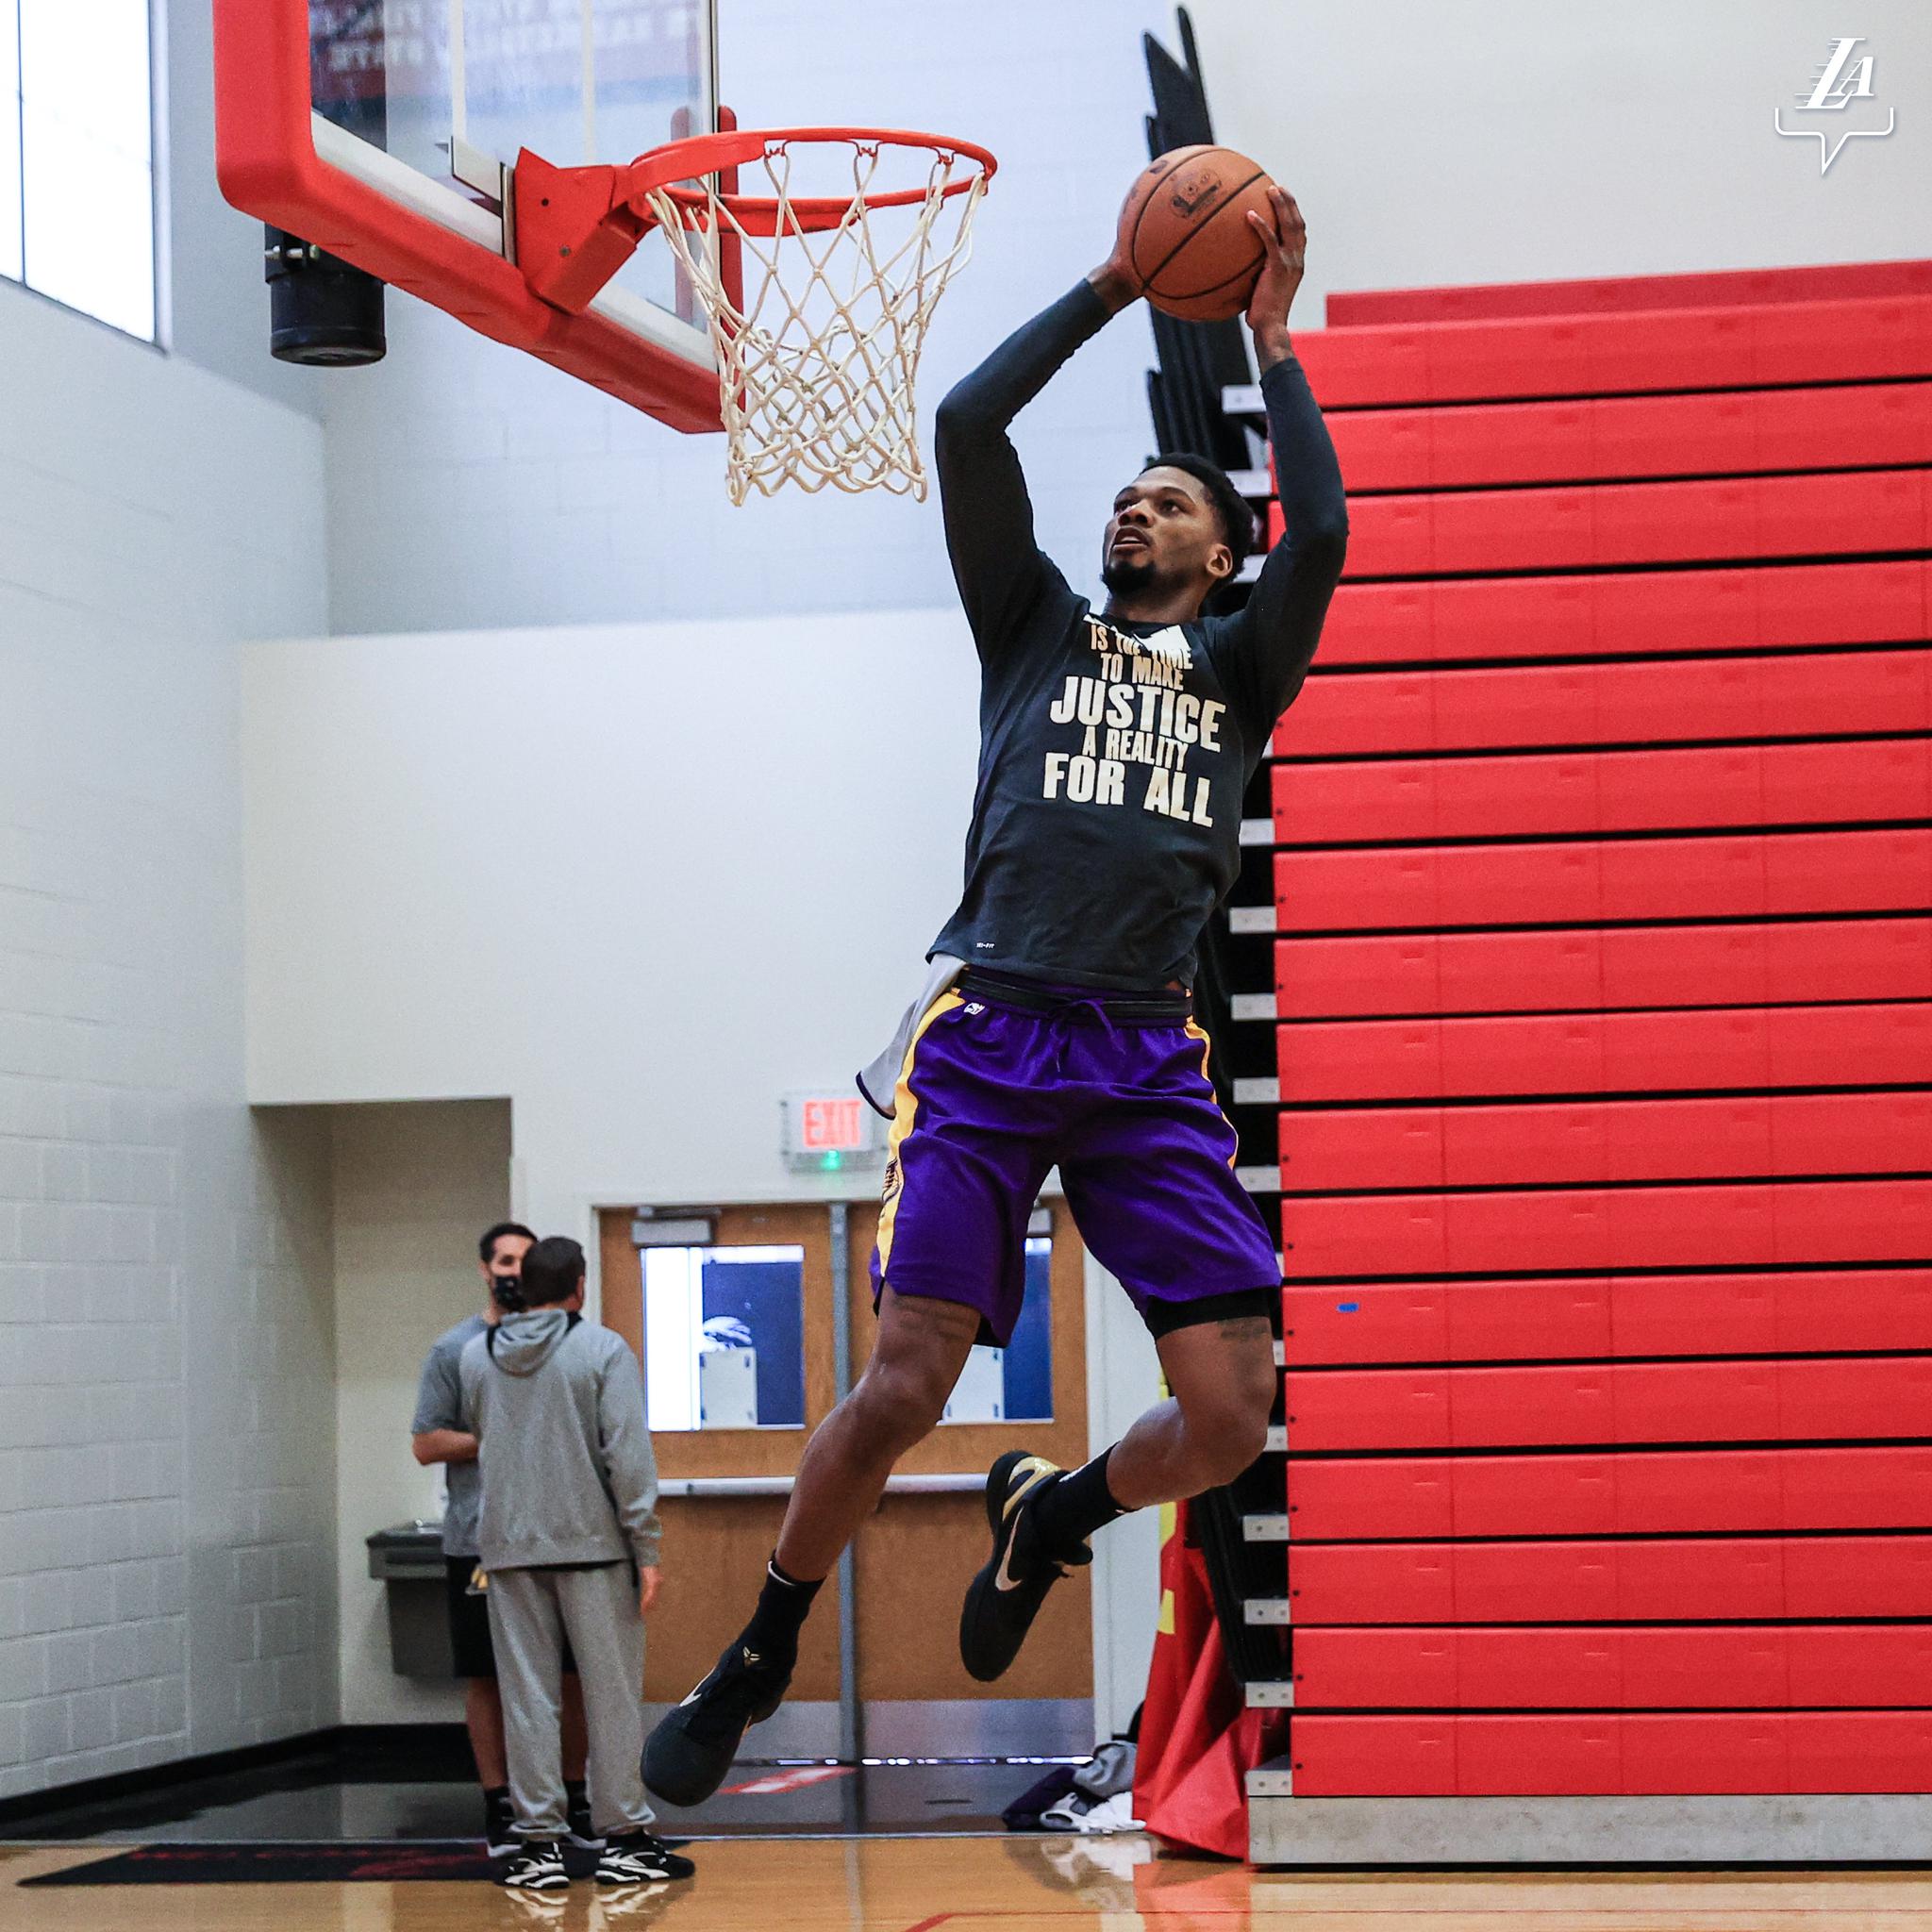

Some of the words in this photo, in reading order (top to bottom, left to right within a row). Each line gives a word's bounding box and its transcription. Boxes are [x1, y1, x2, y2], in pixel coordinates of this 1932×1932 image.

[1091, 625, 1108, 651] IS
[1100, 653, 1124, 684] TO
[1132, 655, 1184, 691] MAKE
[1049, 675, 1226, 753] JUSTICE
[1082, 725, 1096, 758] A
[1105, 728, 1190, 772] REALITY
[1042, 752, 1125, 806] FOR
[1142, 766, 1213, 827] ALL
[804, 1100, 861, 1147] EXIT
